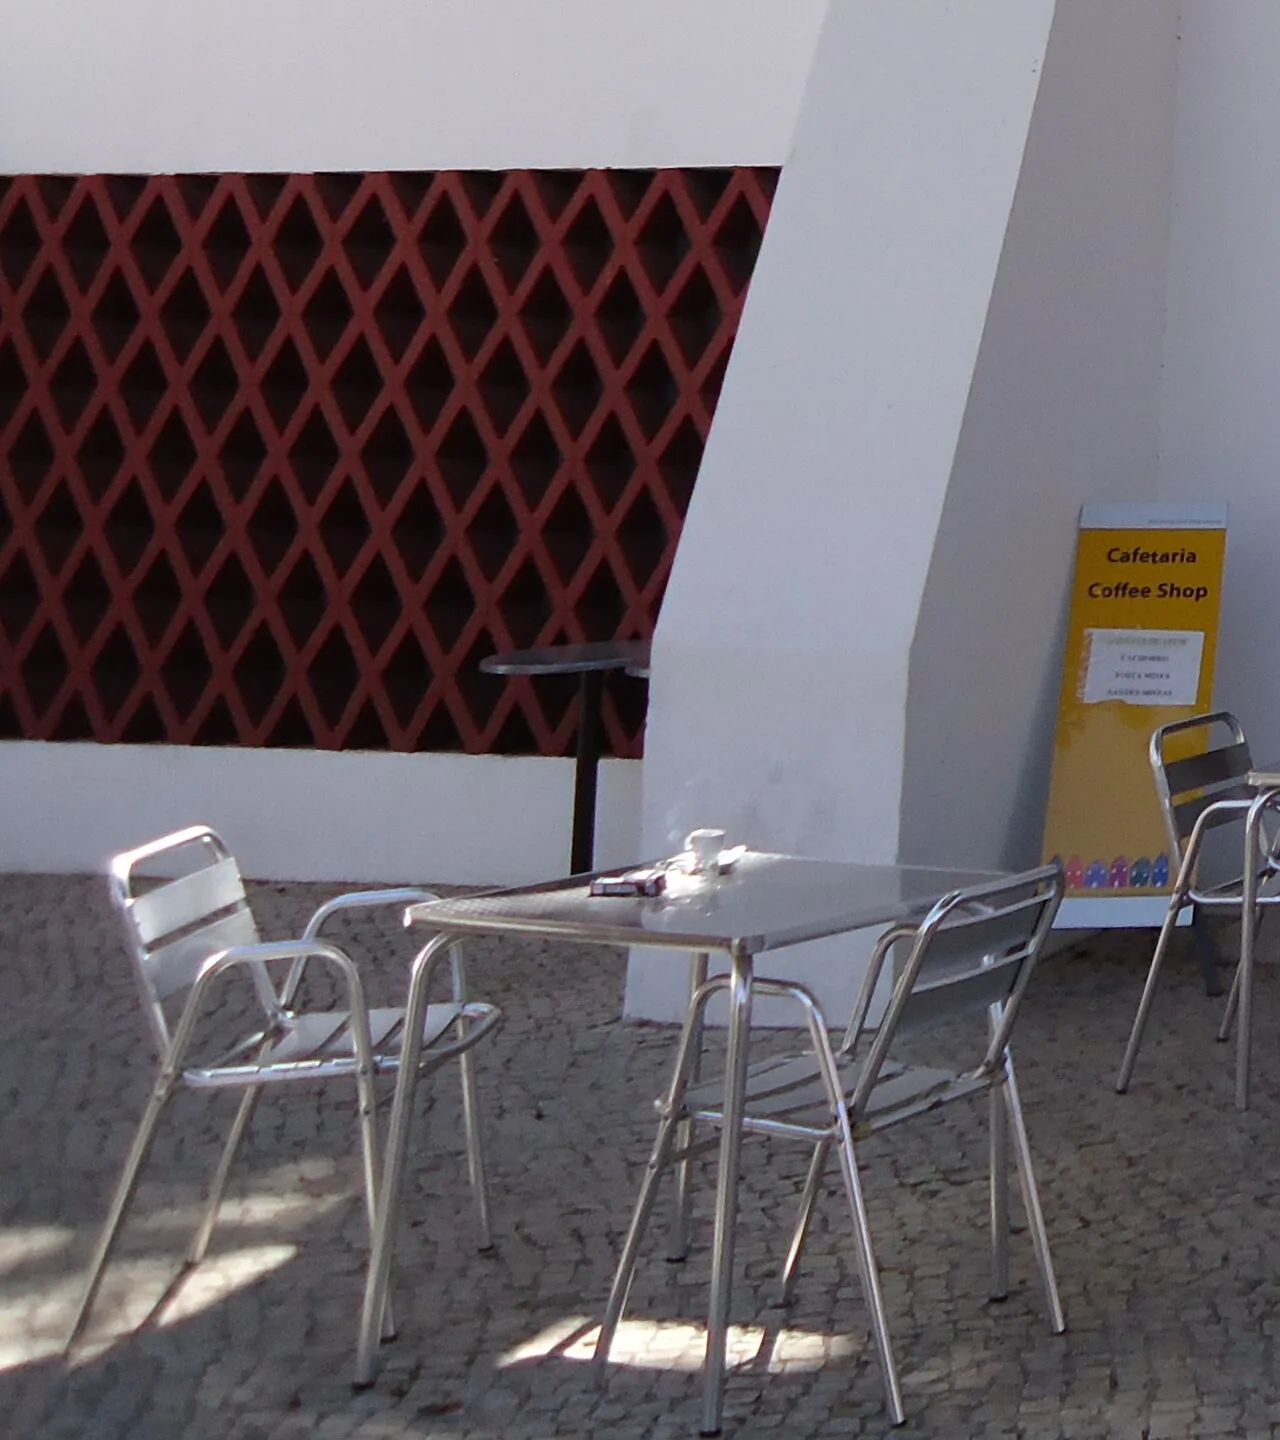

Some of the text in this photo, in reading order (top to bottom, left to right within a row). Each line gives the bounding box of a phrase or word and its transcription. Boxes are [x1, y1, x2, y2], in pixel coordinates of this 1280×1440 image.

[1107, 546, 1197, 564] Cafetaria
[1088, 581, 1209, 602] Coffee Shop
